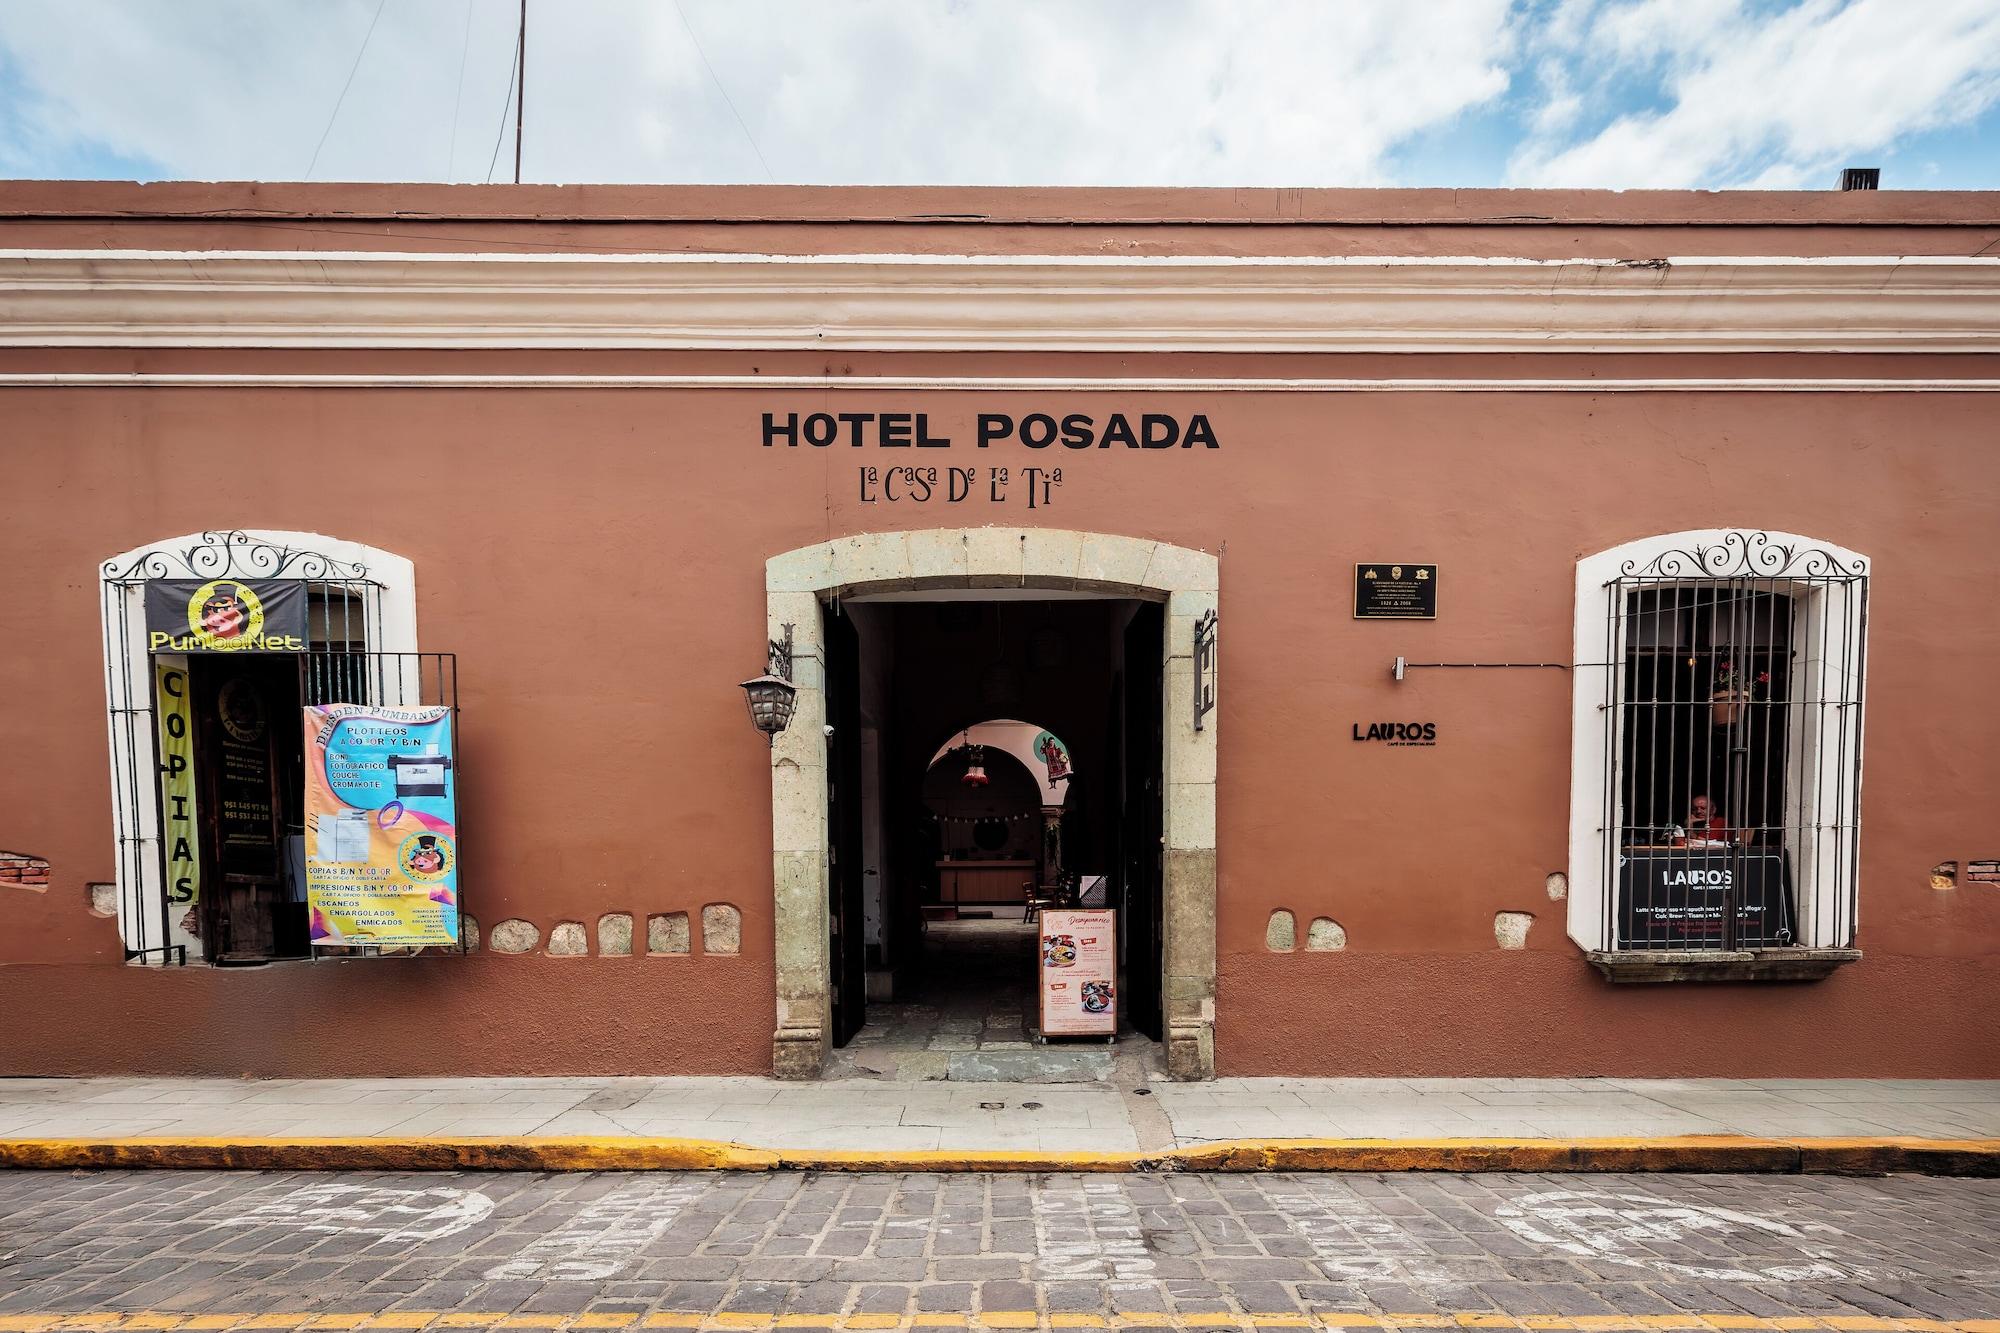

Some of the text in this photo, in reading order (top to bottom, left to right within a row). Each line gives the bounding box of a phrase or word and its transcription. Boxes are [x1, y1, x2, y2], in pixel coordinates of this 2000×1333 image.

[762, 413, 1220, 449] HOTEL POSADA
[858, 466, 879, 503] La
[946, 467, 977, 503] De
[988, 467, 1009, 503] La
[149, 631, 303, 652] PumbaNet
[316, 706, 363, 746] DRESDEN
[347, 727, 408, 735] PLOTTEOS
[1353, 722, 1436, 741] LAUROS
[349, 737, 385, 746] COOR
[402, 738, 421, 746] B/N
[163, 671, 194, 903] COPIAS
[309, 867, 392, 876] COPIAS B/N Y COOR
[310, 884, 414, 892] IMPRESIONES B/N Y COOR
[317, 900, 360, 908] ESCANEOS
[329, 909, 396, 917] ENGARGOLADOS
